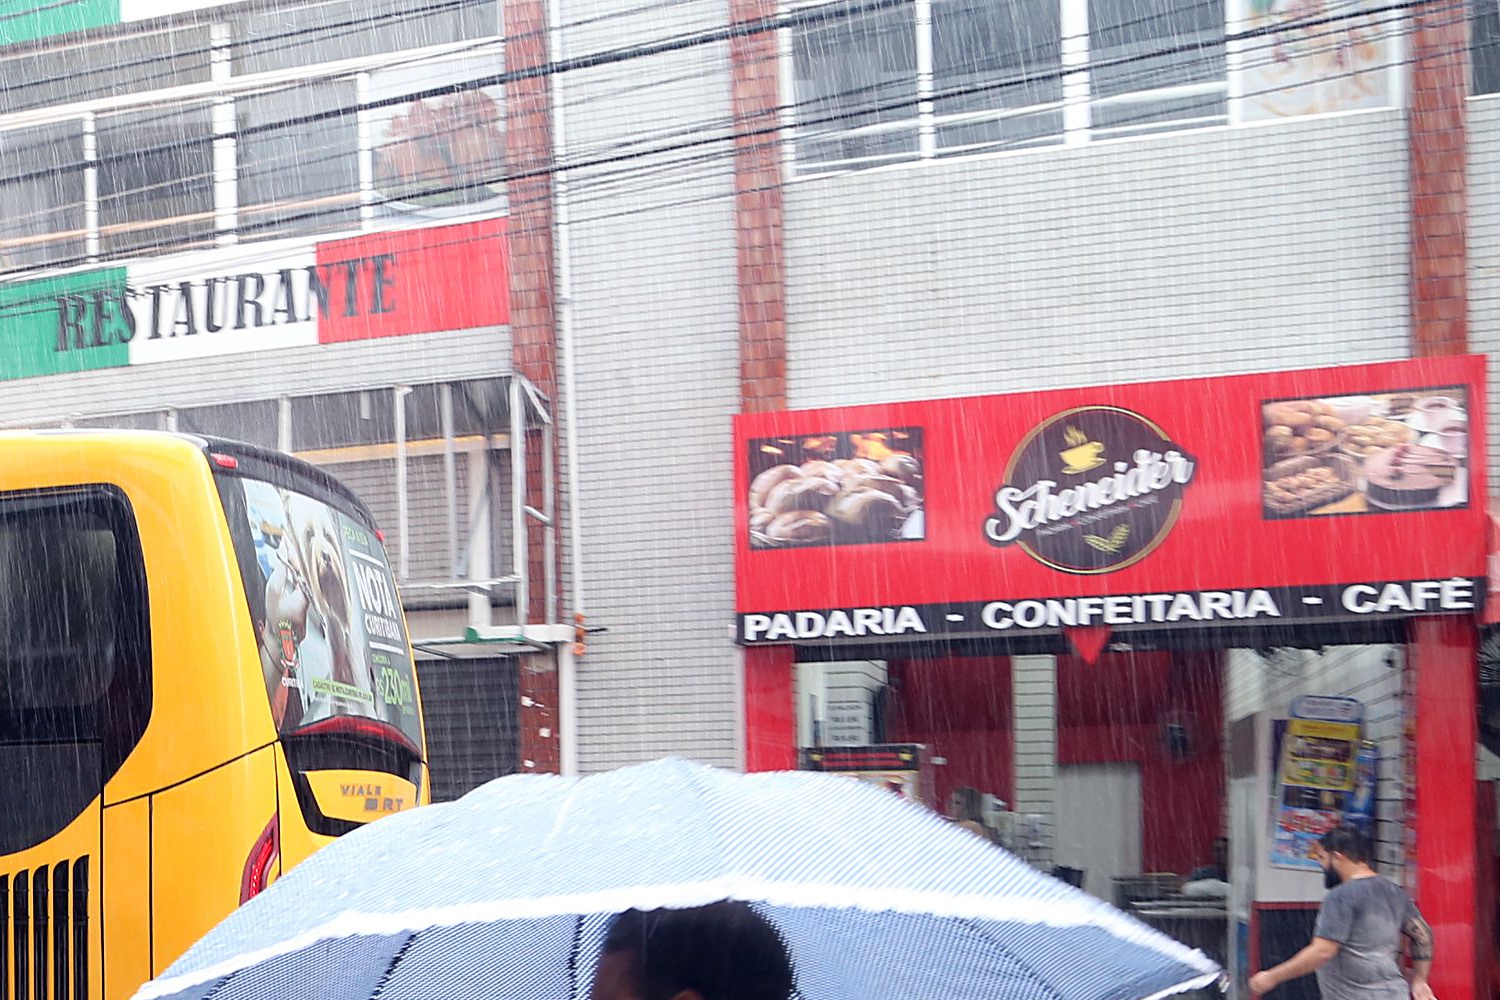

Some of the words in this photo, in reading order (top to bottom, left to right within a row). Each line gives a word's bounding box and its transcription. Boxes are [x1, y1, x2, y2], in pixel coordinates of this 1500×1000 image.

[53, 253, 397, 352] RESTAURANTE
[352, 561, 398, 620] NOTA
[743, 606, 927, 641] PADARIA
[981, 589, 1282, 630] CONFEITARIA
[1341, 577, 1475, 614] CAFÉ
